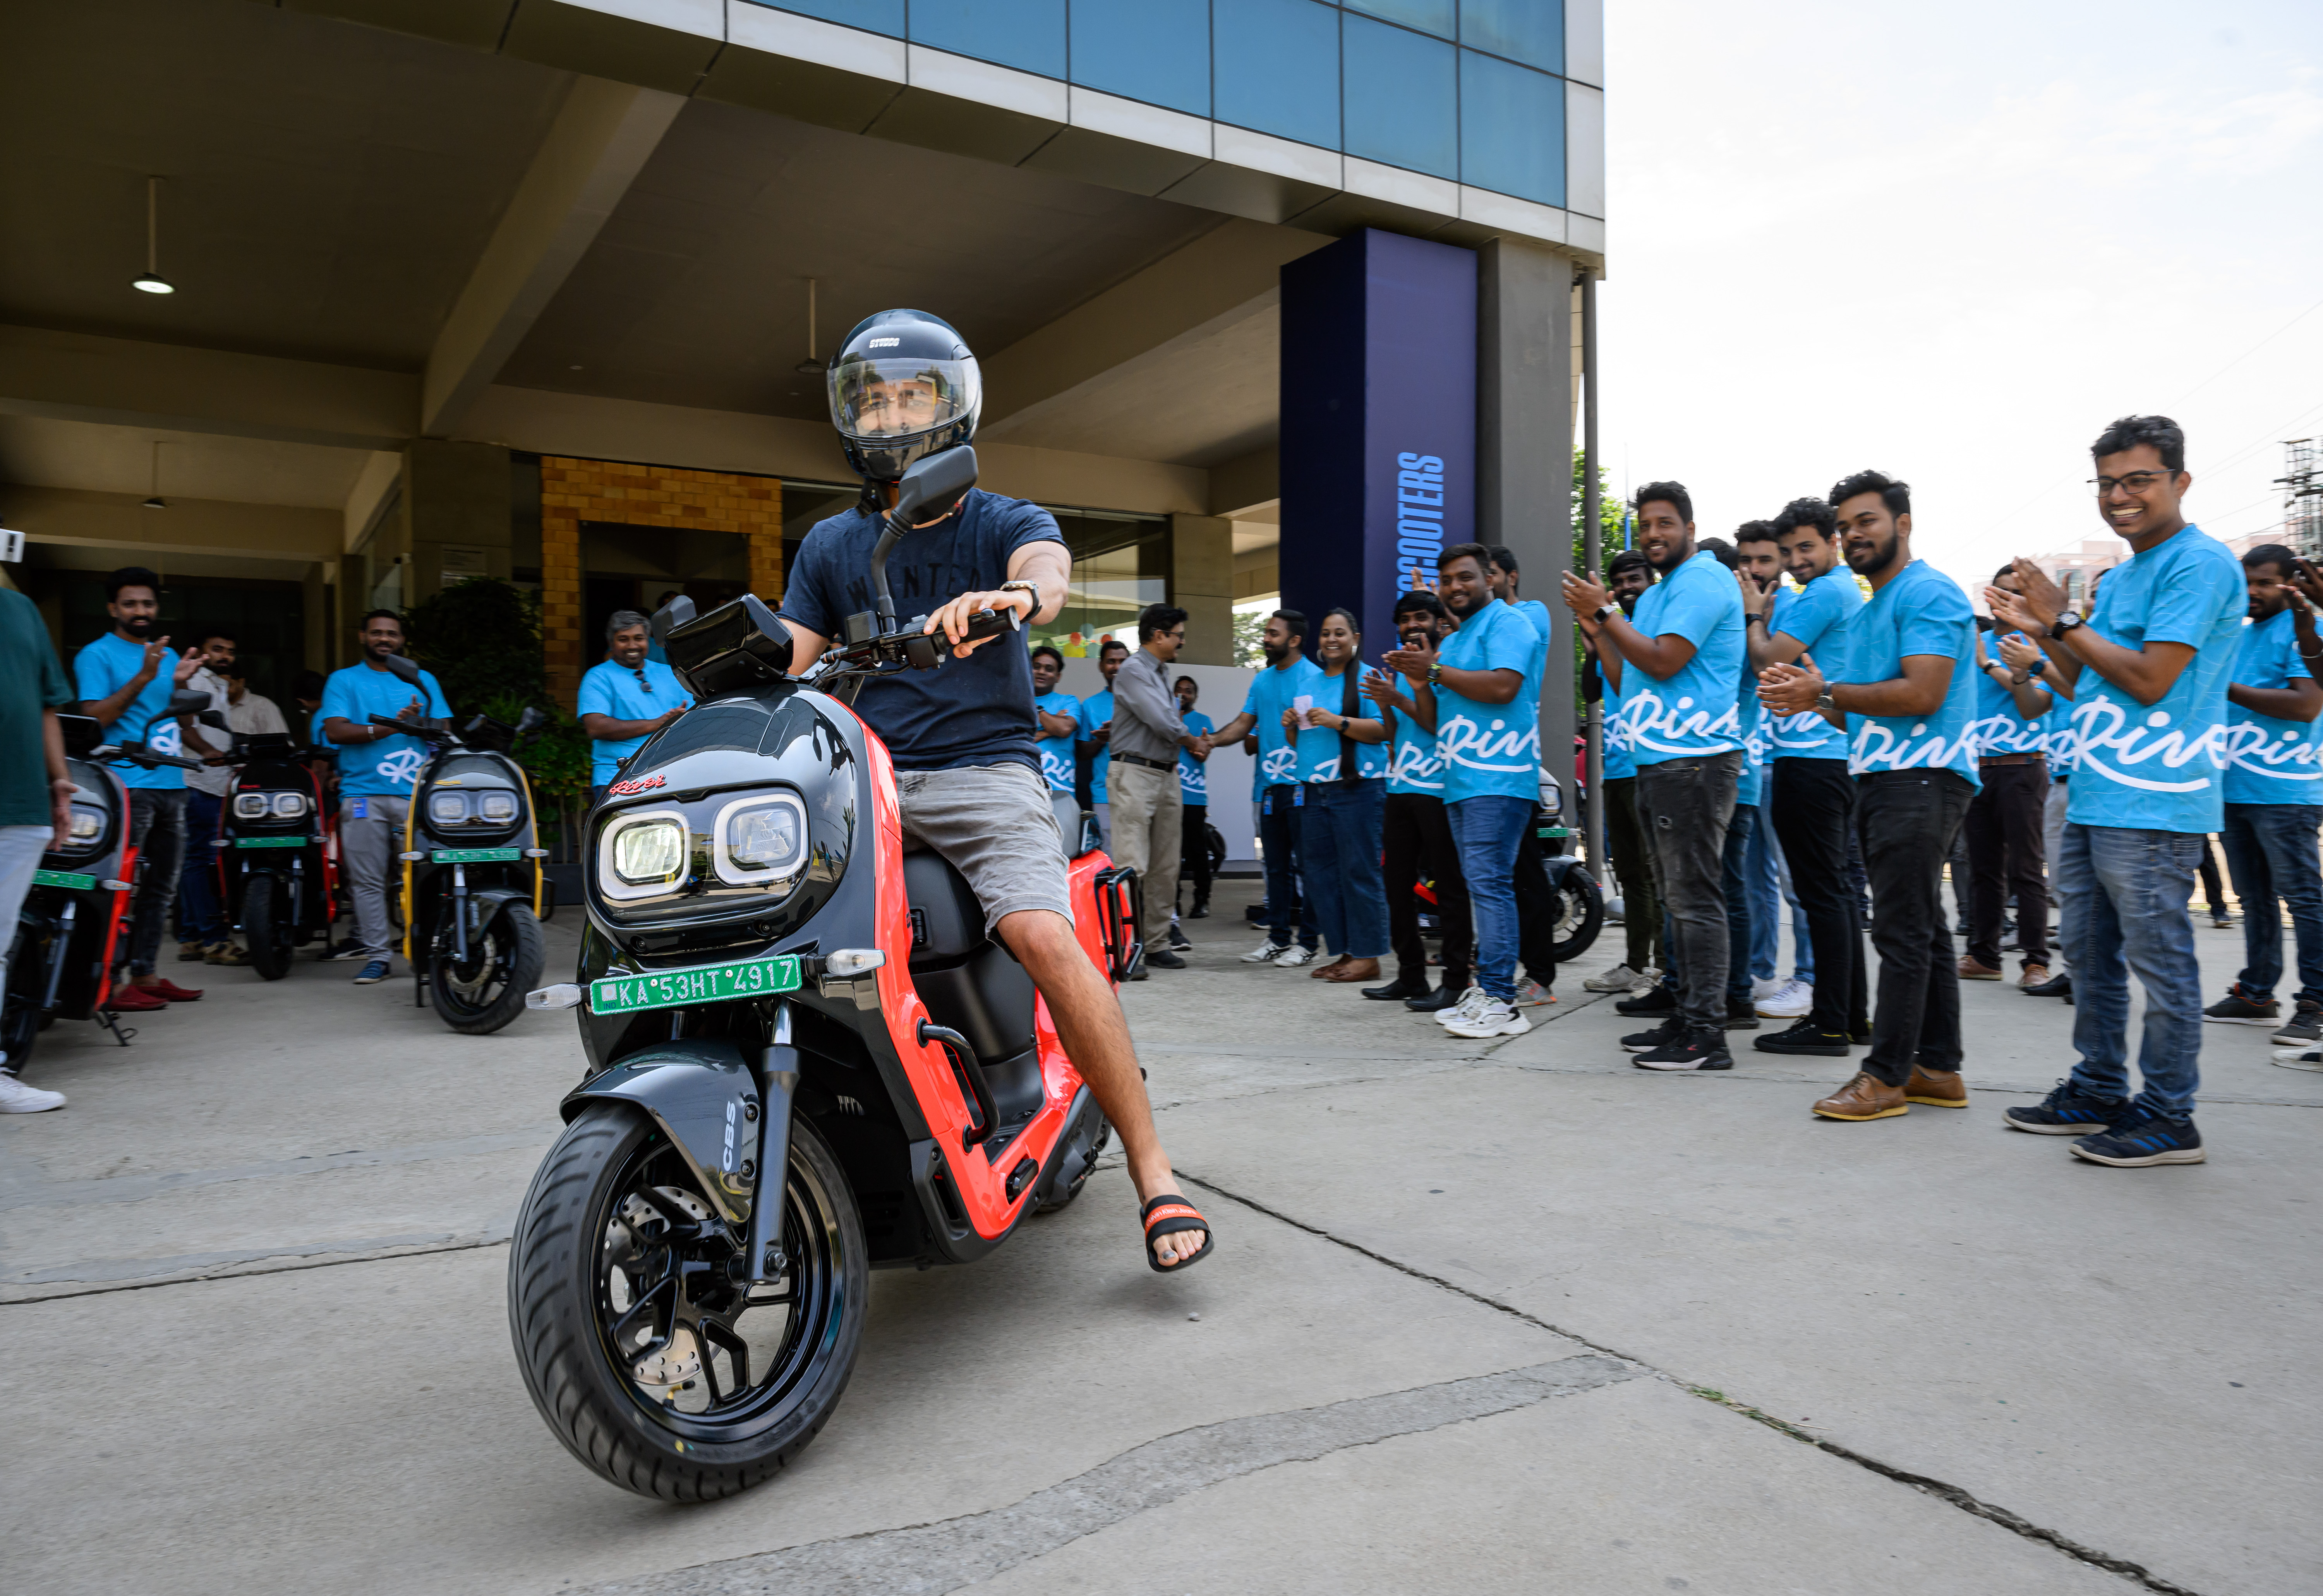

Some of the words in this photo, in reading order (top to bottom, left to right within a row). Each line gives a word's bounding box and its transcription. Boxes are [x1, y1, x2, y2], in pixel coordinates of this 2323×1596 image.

[609, 774, 666, 795] River
[619, 980, 649, 1006] KA
[660, 971, 720, 1001] 53HT
[734, 960, 793, 992] 4917
[723, 1101, 736, 1172] CBS
